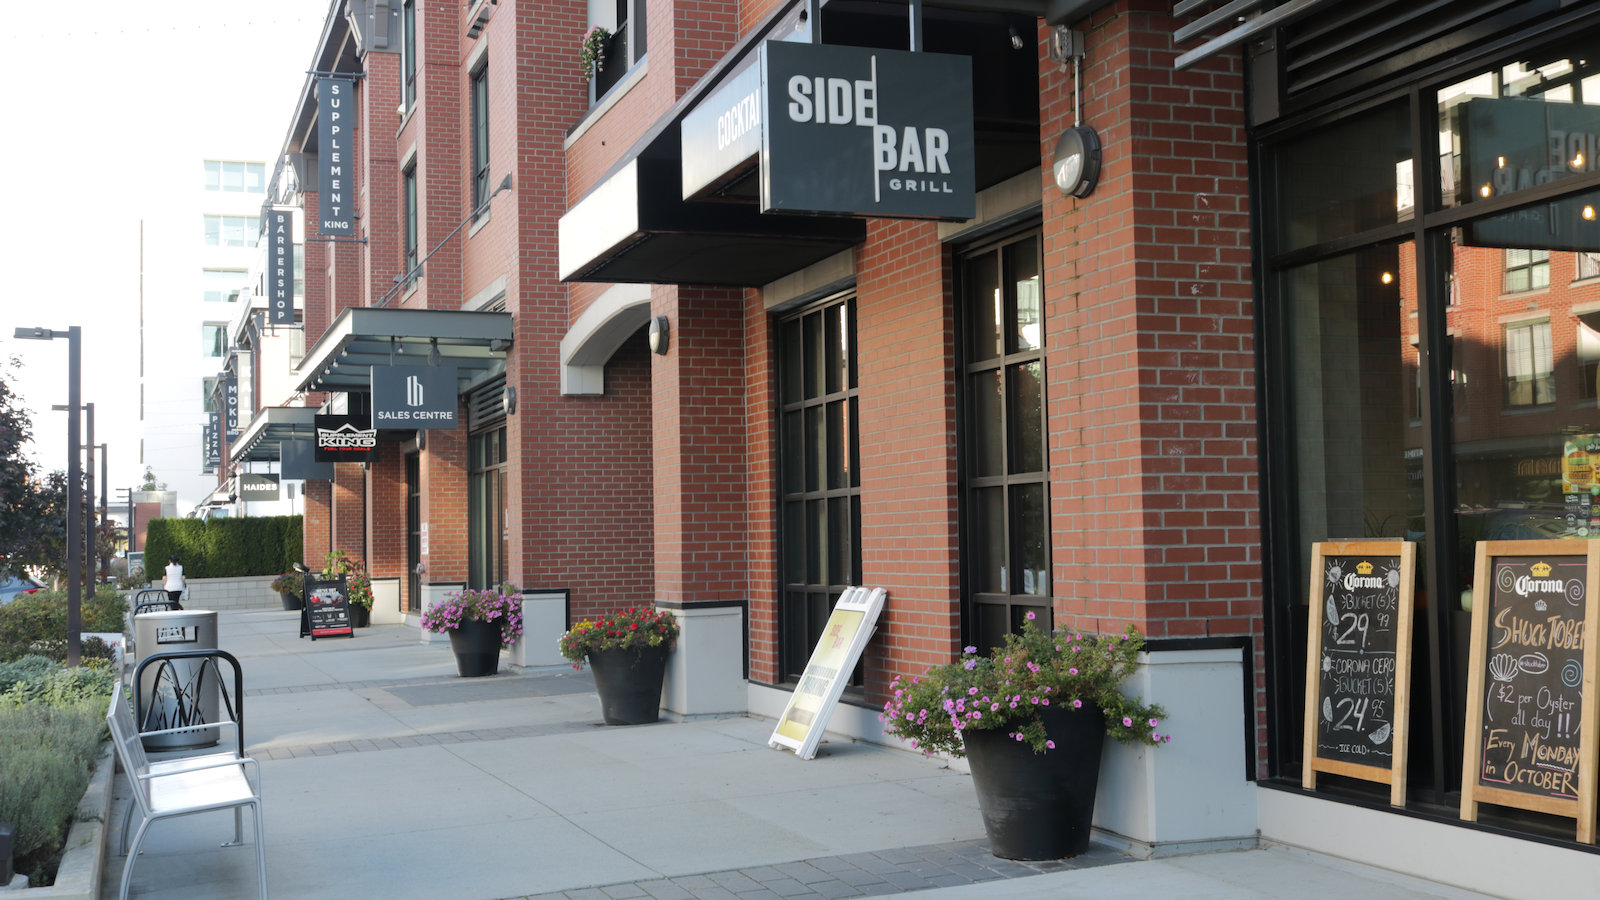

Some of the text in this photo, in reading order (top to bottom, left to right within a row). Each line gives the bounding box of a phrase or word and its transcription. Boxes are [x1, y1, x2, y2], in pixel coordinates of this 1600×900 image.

[788, 74, 874, 127] SIDE
[331, 85, 341, 216] SUPPLEMENT
[873, 124, 951, 174] BAR
[889, 178, 953, 193] GRILL
[324, 221, 349, 229] KING
[277, 215, 285, 319] BARBERSHOP
[228, 385, 237, 428] MOKU
[378, 411, 453, 420] SALES CENTRE
[318, 437, 376, 447] KING
[243, 483, 278, 491] HAIDES
[1344, 572, 1384, 593] Corona
[1515, 574, 1564, 598] Corona
[1335, 657, 1395, 677] CORONA CERO
[1371, 698, 1386, 718] 95
[1497, 684, 1575, 716] $2 per Oyster
[1511, 708, 1526, 726] all
[1530, 709, 1551, 740] day
[1351, 744, 1367, 755] COLD
[1520, 730, 1580, 772] MONDAY
[1485, 760, 1580, 796] in OCTOBER
